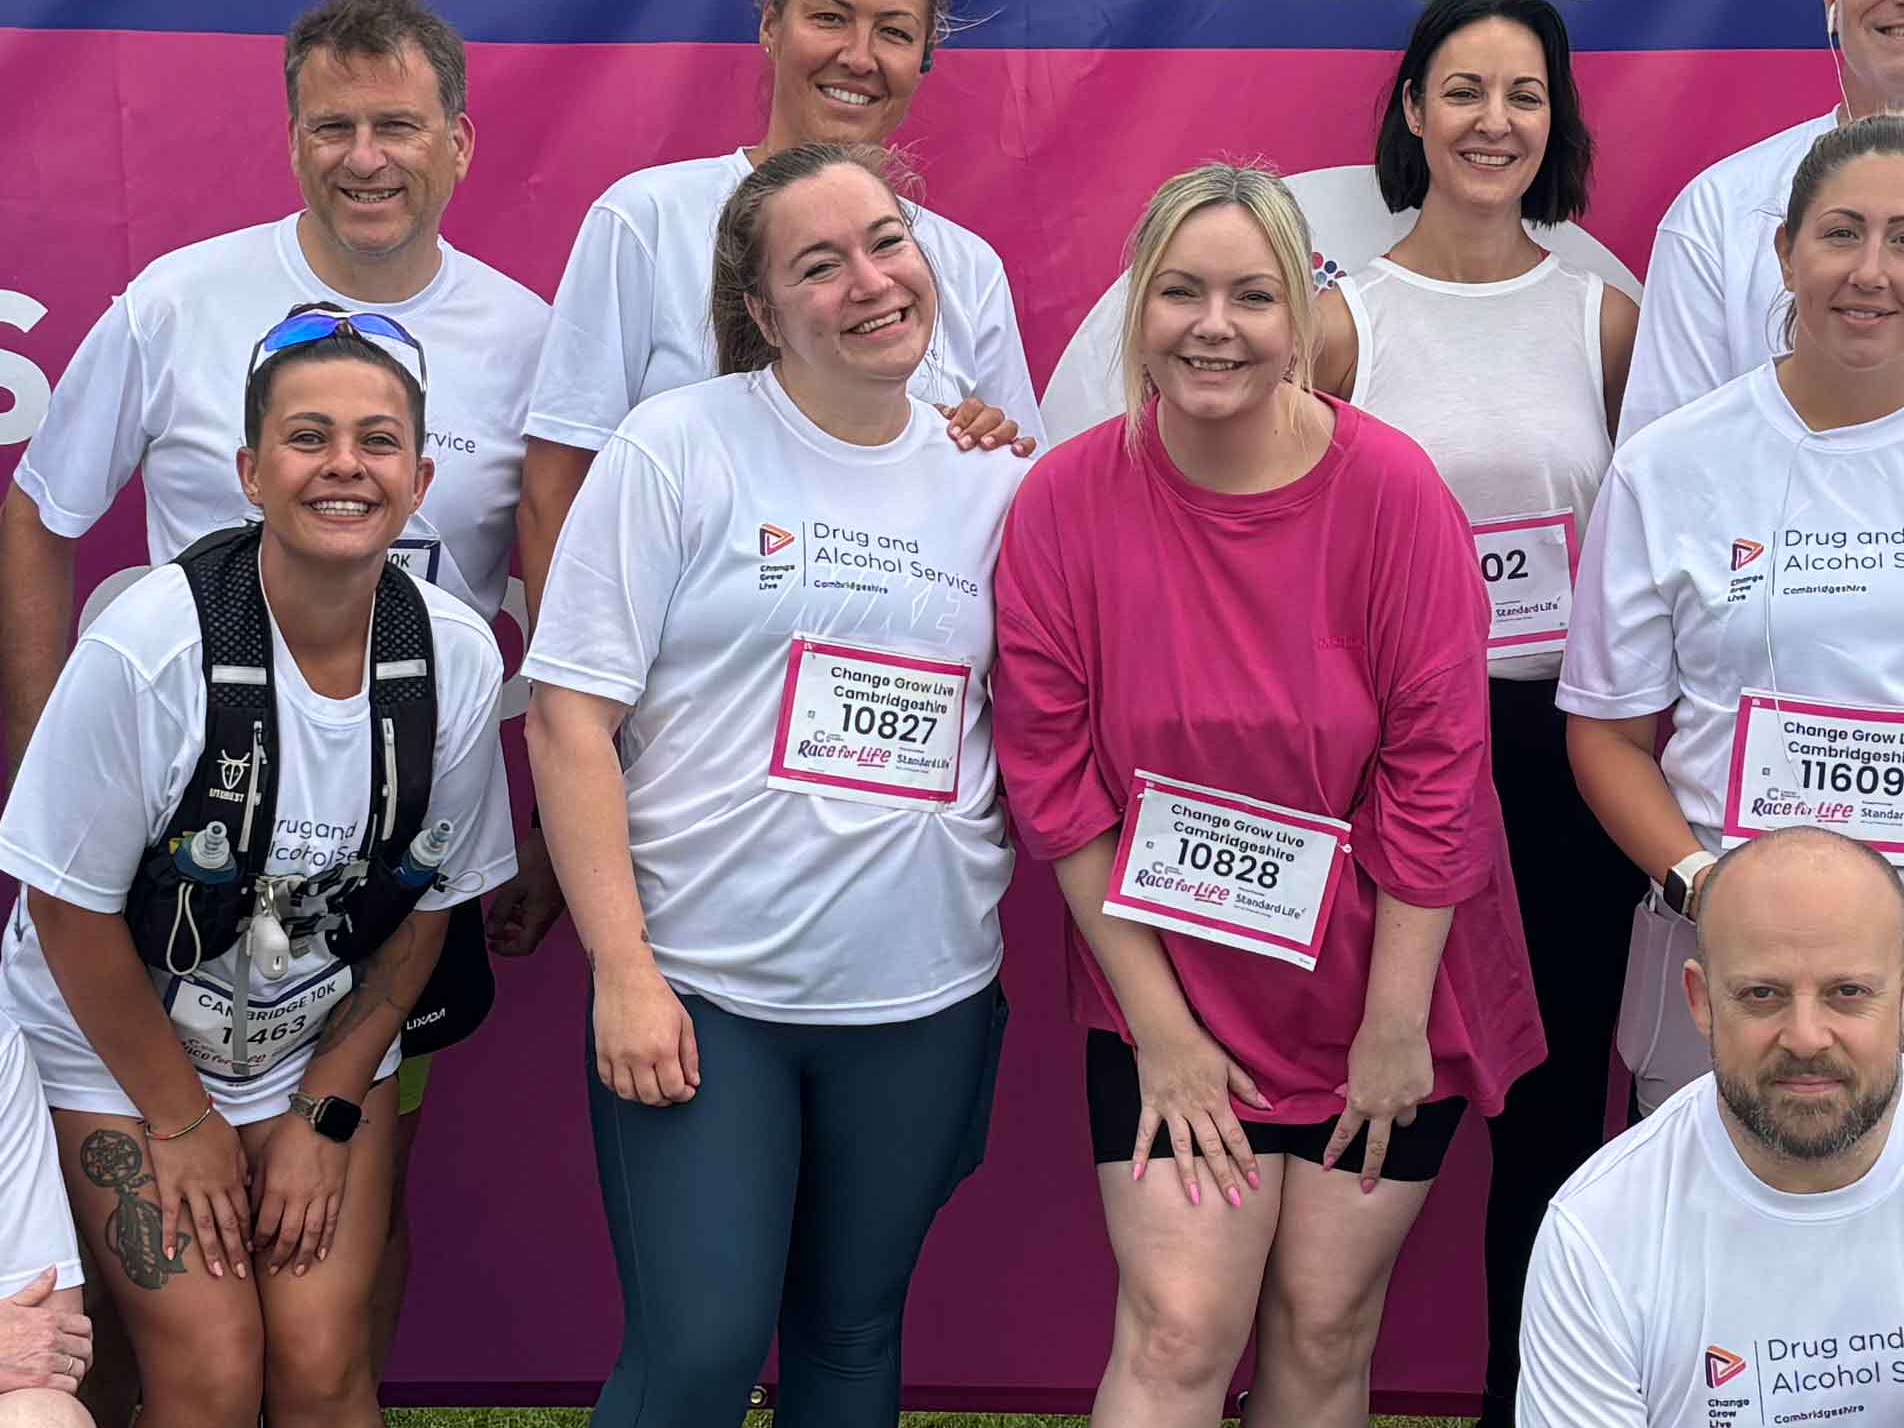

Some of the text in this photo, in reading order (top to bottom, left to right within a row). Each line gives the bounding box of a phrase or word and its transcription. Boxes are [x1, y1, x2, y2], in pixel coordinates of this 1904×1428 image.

[425, 431, 476, 454] rvice
[814, 523, 919, 554] Drug and
[1785, 529, 1847, 548] Drug
[815, 548, 978, 597] Alcohol Service
[1784, 553, 1883, 572] Alcohol
[831, 666, 890, 688] Change
[894, 677, 932, 694] Grow
[833, 686, 947, 714] Cambridgeshire
[842, 704, 937, 745] 10827
[1784, 721, 1848, 742] Change
[1852, 729, 1896, 744] Grow
[798, 740, 891, 764] Race for Life
[1801, 759, 1904, 796] 11609
[1752, 798, 1792, 817] Race
[1815, 802, 1854, 819] Life
[277, 820, 358, 840] rug and
[1171, 803, 1305, 849] Change Grow Live
[269, 844, 335, 866] lcohol
[1174, 821, 1295, 863] Cambridgeshire
[1177, 837, 1280, 889] 10828
[1135, 868, 1173, 891] Race
[1175, 878, 1195, 894] for
[1194, 880, 1230, 902] Life
[312, 980, 336, 1003] 10K
[221, 1014, 307, 1046] 1463
[1768, 1326, 1904, 1361] Drug and
[1772, 1362, 1880, 1395] Alcohol
[1774, 1405, 1864, 1424] Cambridgeshire
